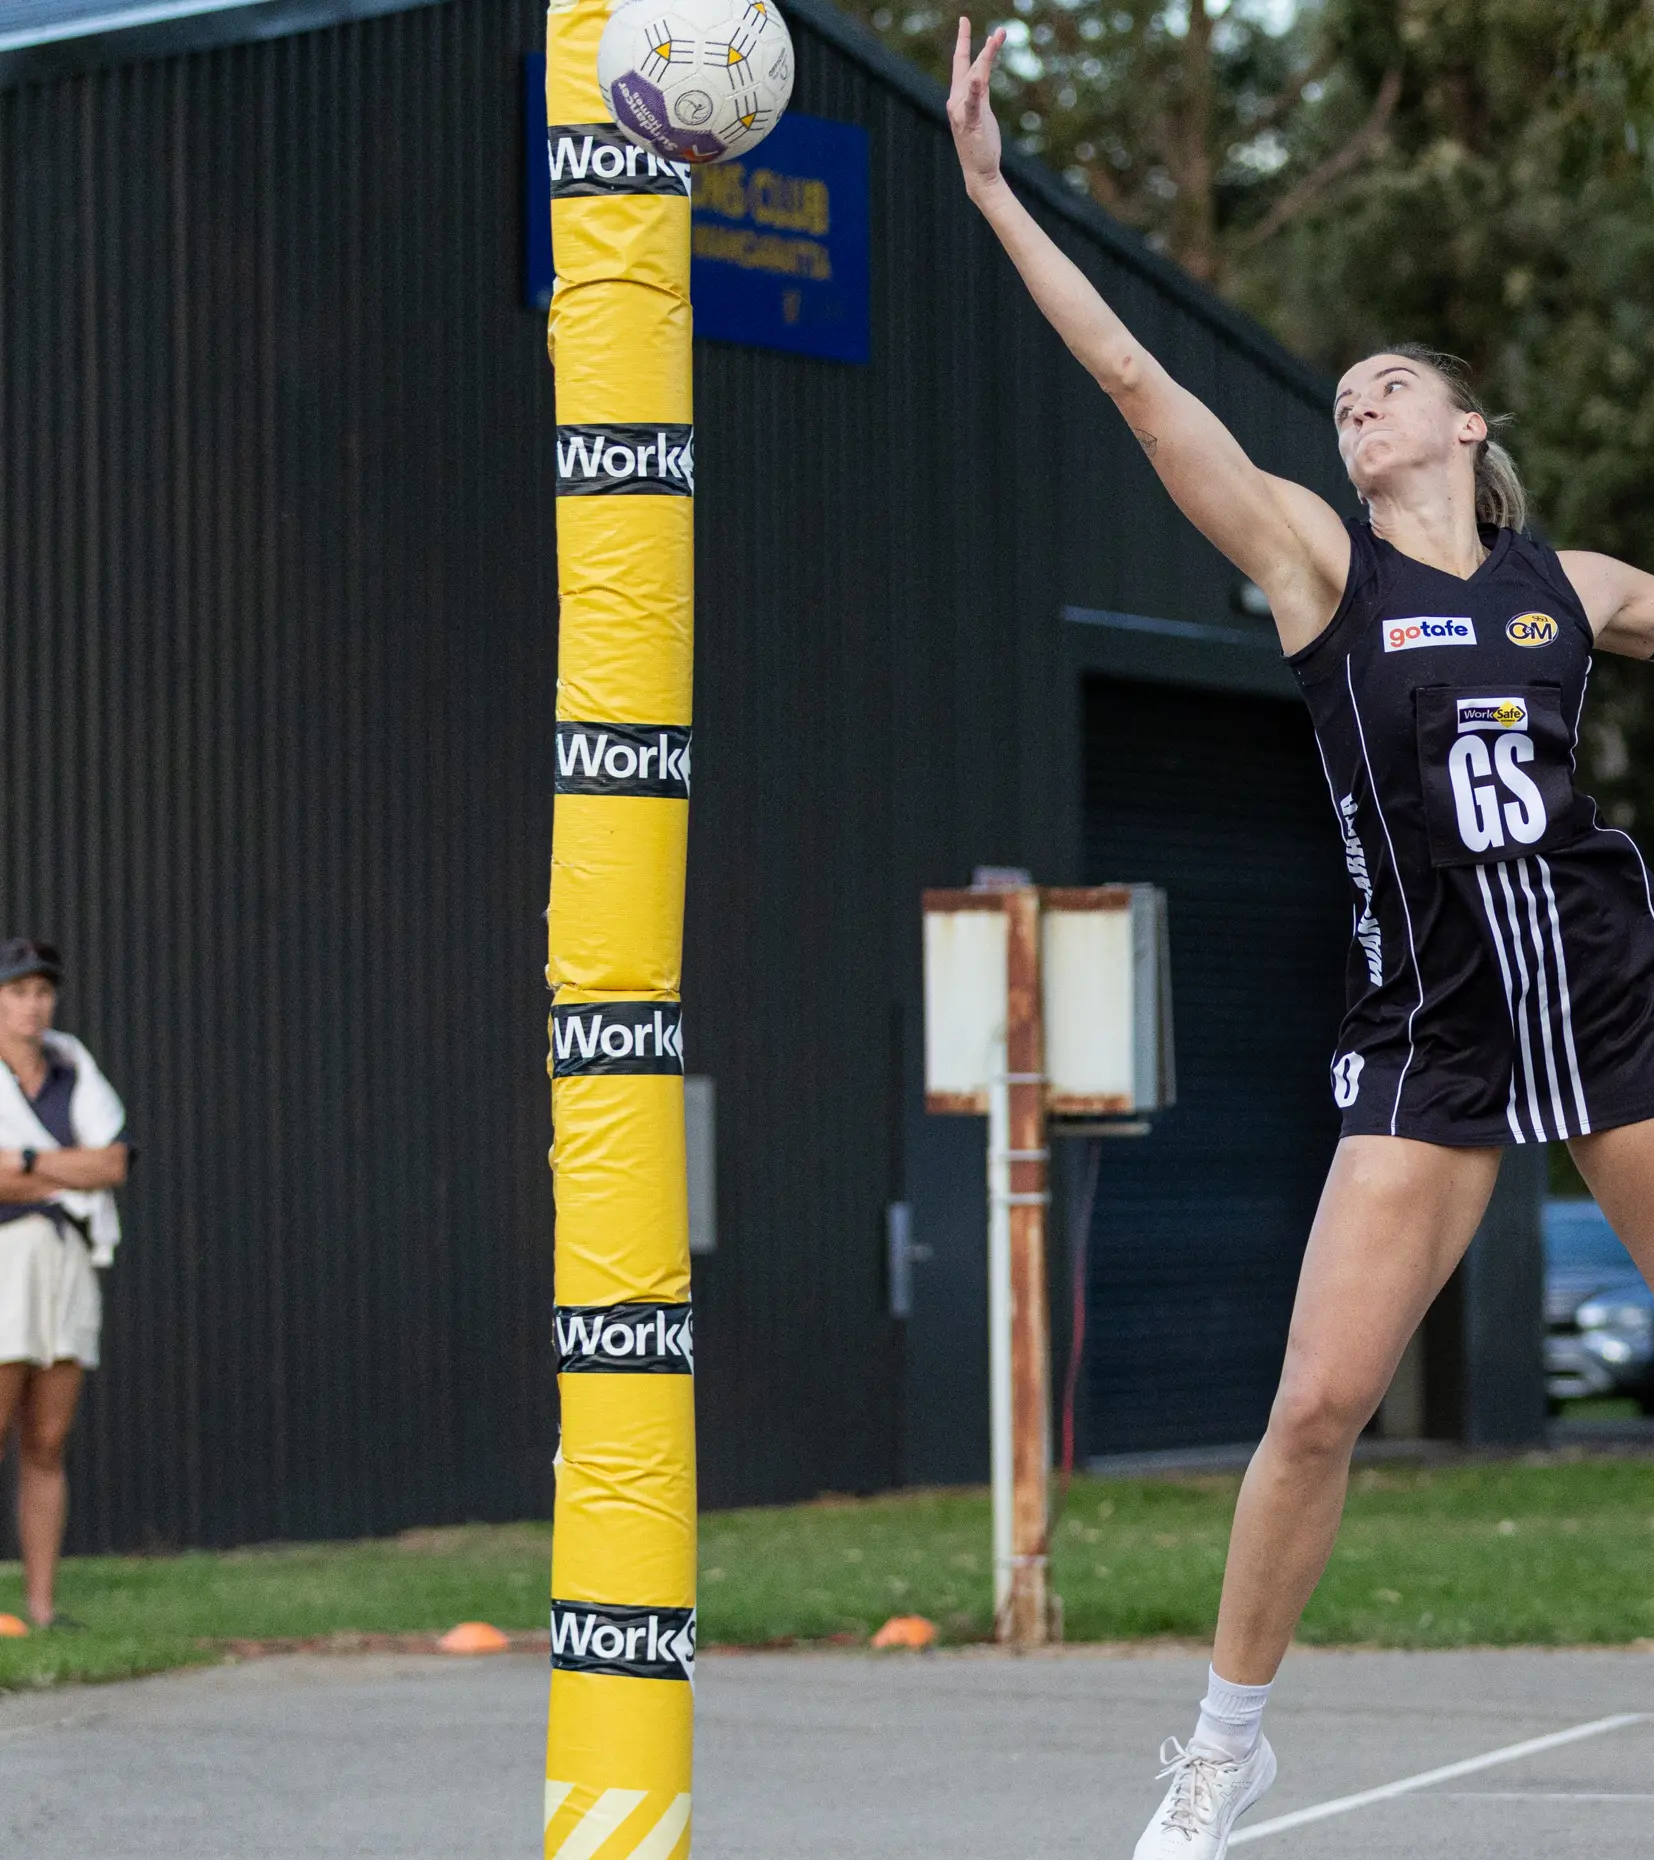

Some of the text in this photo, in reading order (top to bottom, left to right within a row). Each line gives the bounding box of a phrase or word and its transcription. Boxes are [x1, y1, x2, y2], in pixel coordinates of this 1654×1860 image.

[753, 168, 829, 235] CLUB
[1389, 620, 1468, 648] gotafe
[1449, 733, 1547, 852] GS
